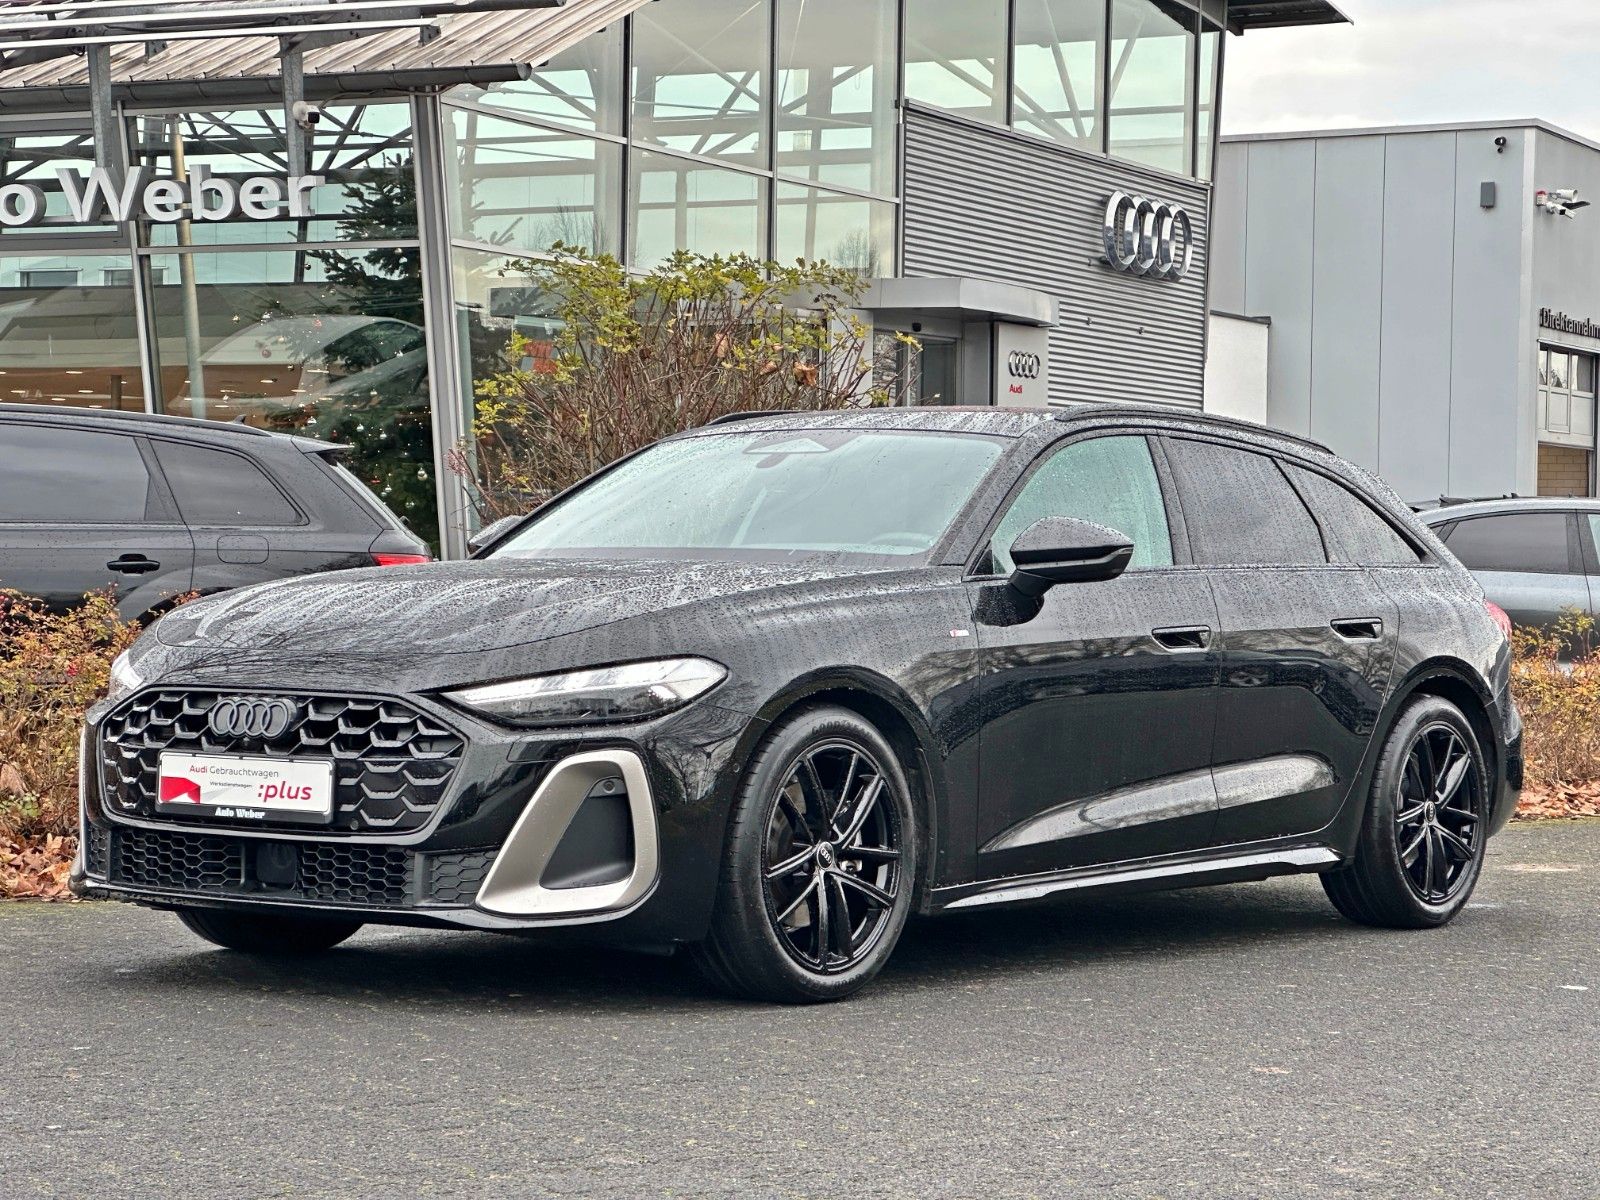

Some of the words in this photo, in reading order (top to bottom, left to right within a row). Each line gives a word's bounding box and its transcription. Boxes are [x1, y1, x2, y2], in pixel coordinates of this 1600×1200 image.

[55, 163, 325, 223] Weber
[1009, 384, 1023, 394] Audi
[189, 765, 208, 774] Audi
[209, 766, 279, 779] Gebrauchtwagen
[214, 806, 234, 817] Auto
[235, 808, 266, 819] Weber
